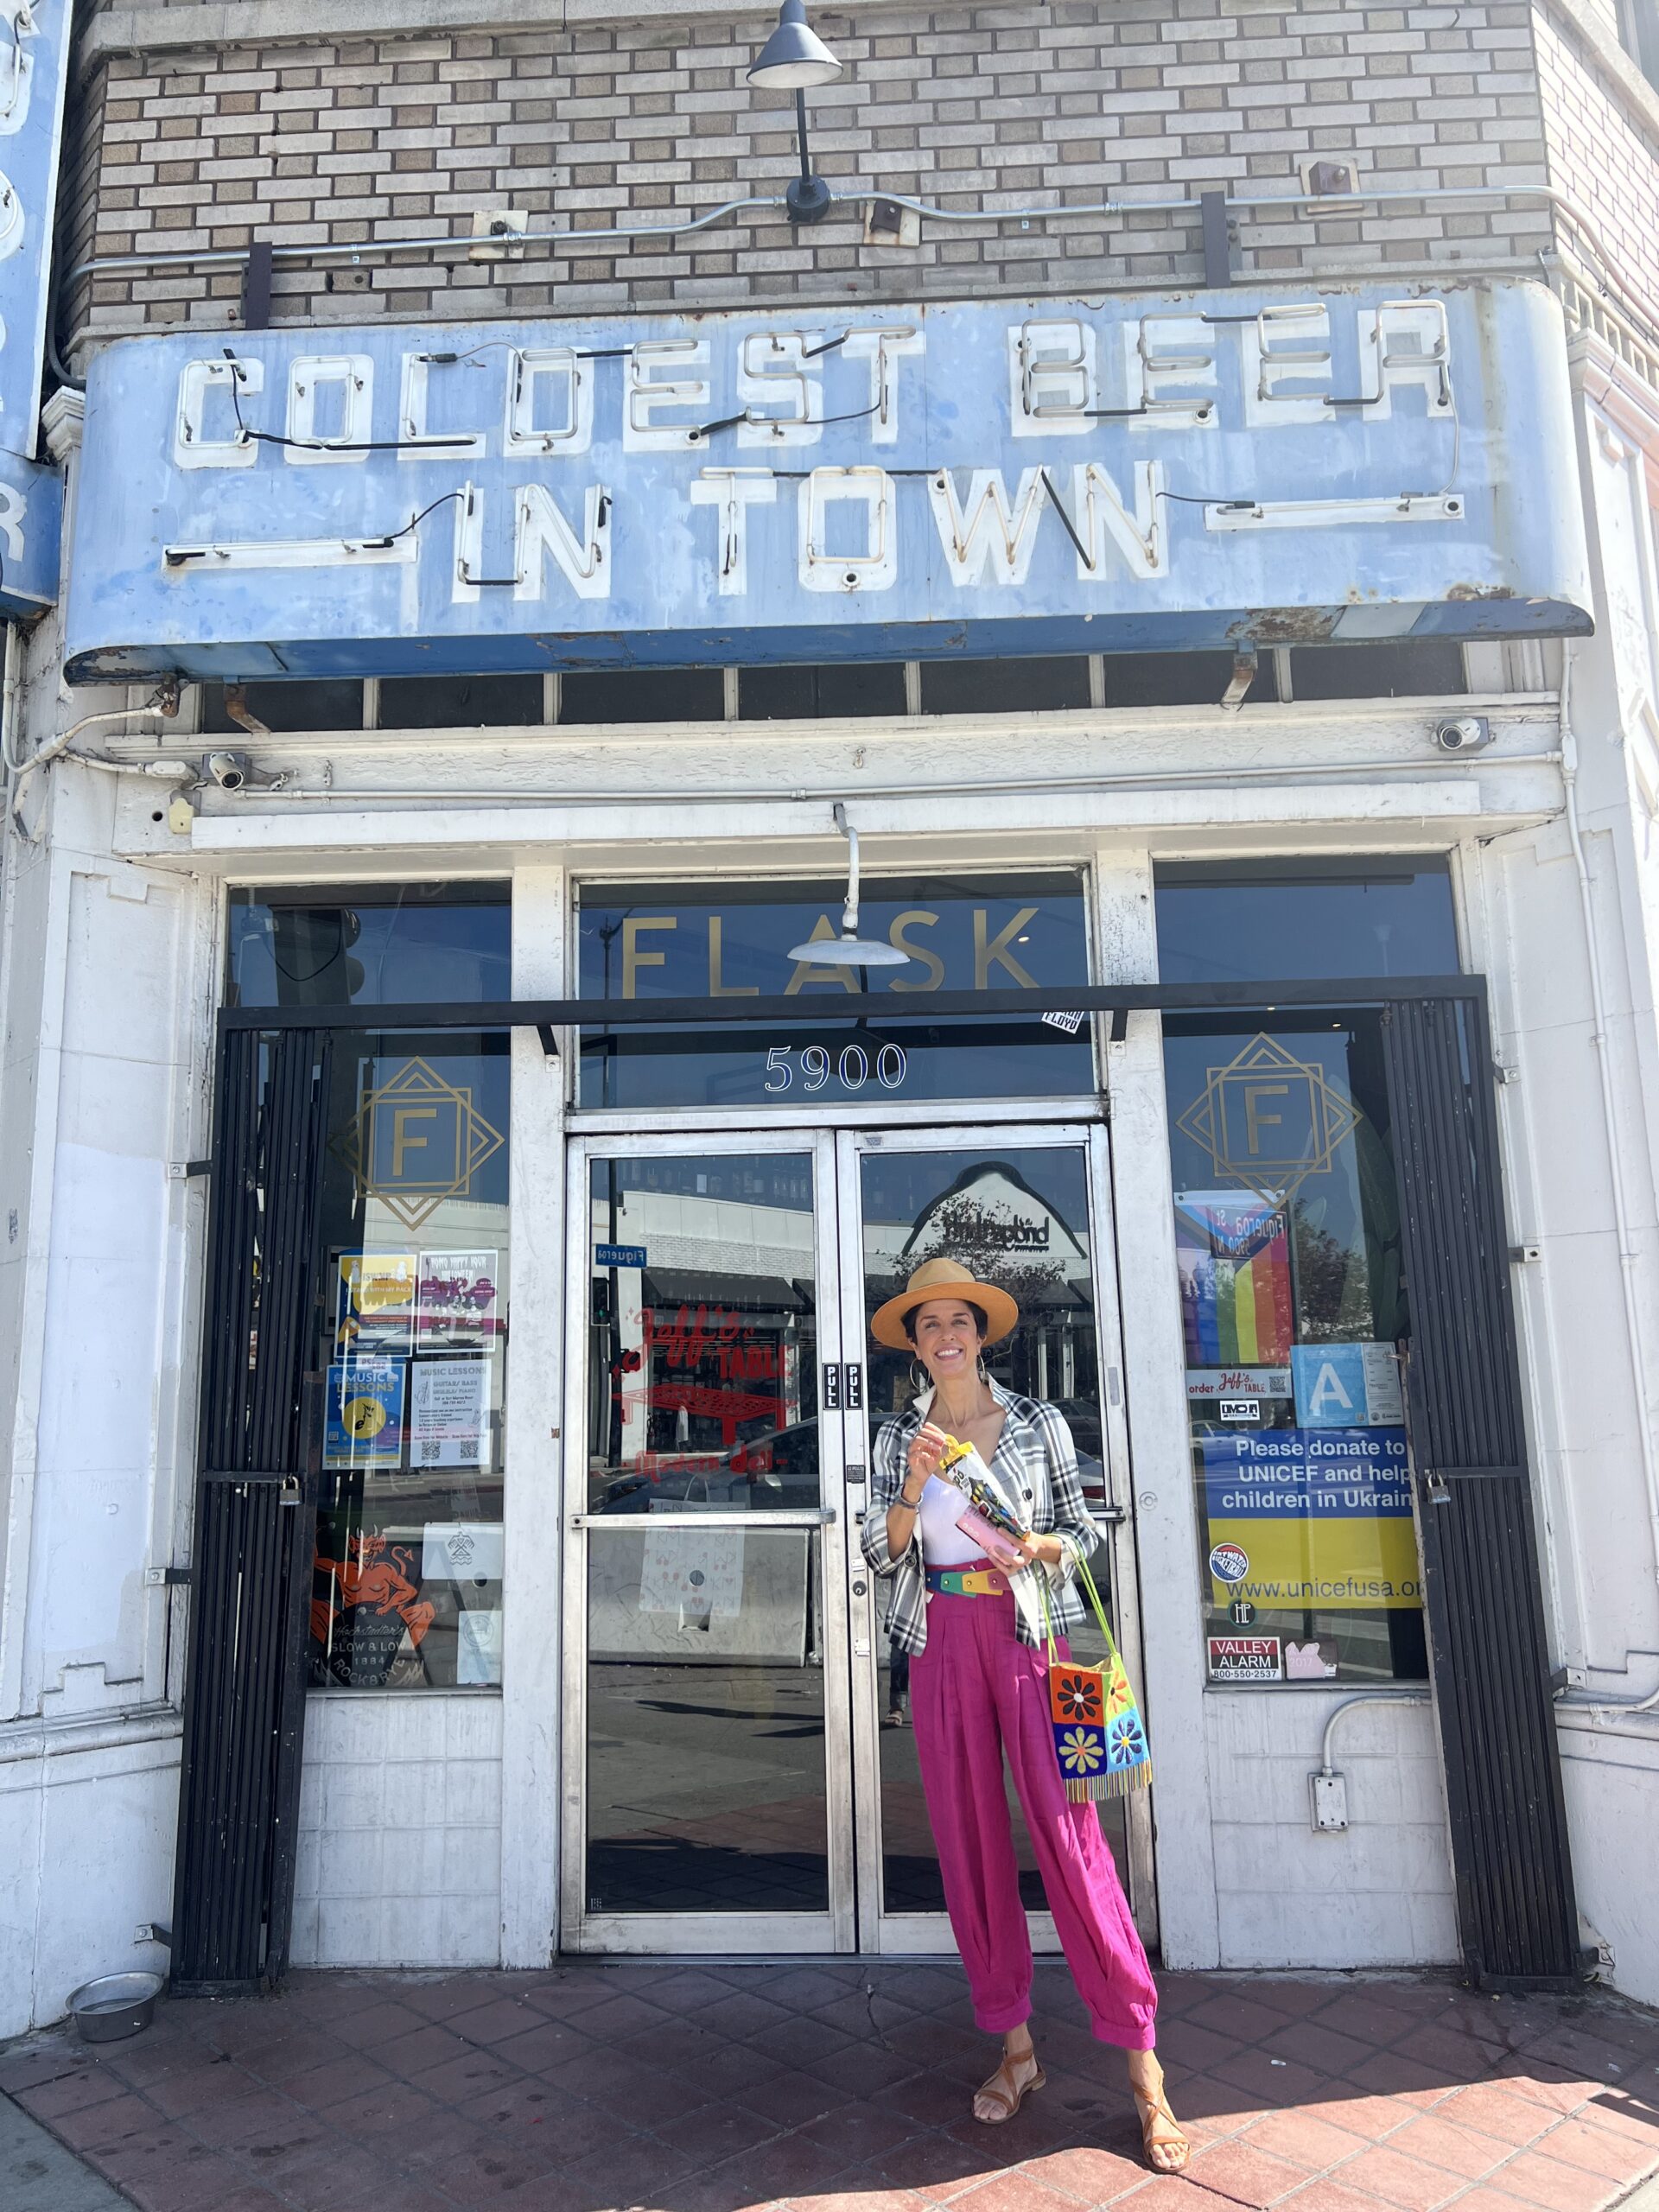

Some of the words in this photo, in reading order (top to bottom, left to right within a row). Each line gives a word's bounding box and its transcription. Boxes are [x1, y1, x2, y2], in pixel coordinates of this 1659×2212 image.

[174, 326, 925, 468] COLDEST
[1007, 300, 1454, 437] BEER
[451, 480, 612, 603] IN
[691, 461, 1169, 597] TOWN
[622, 907, 1041, 999] FLASK
[765, 1043, 907, 1092] 5900
[1244, 1085, 1288, 1154] F
[392, 1109, 436, 1176] F
[622, 1303, 741, 1372] Jeff's
[420, 1368, 446, 1376] MUSIC
[716, 1344, 793, 1379] TABLE
[337, 1382, 395, 1393] LESSONS
[346, 1372, 385, 1382] MUSIC
[827, 1366, 836, 1407] PULL
[849, 1366, 859, 1407] PULL
[1188, 1382, 1215, 1394] order
[1218, 1371, 1250, 1391] Jeff's
[1244, 1383, 1265, 1393] TABLE
[1309, 1363, 1354, 1410] A
[1236, 1440, 1303, 1457] Please
[1309, 1440, 1380, 1456] donate
[1385, 1440, 1405, 1456] to
[1238, 1465, 1318, 1483] UNICEF
[1325, 1465, 1362, 1482] and
[1369, 1465, 1412, 1484] help
[1222, 1491, 1310, 1509] children
[1318, 1491, 1337, 1508] in
[332, 1642, 365, 1652] SLOW
[368, 1642, 377, 1652] &
[380, 1642, 406, 1652] LOW
[354, 1656, 385, 1666] 1884
[1216, 1641, 1272, 1654] VALLEY
[334, 1658, 368, 1686] ROCK
[378, 1658, 405, 1683] RYE
[1219, 1656, 1271, 1668] ALARM
